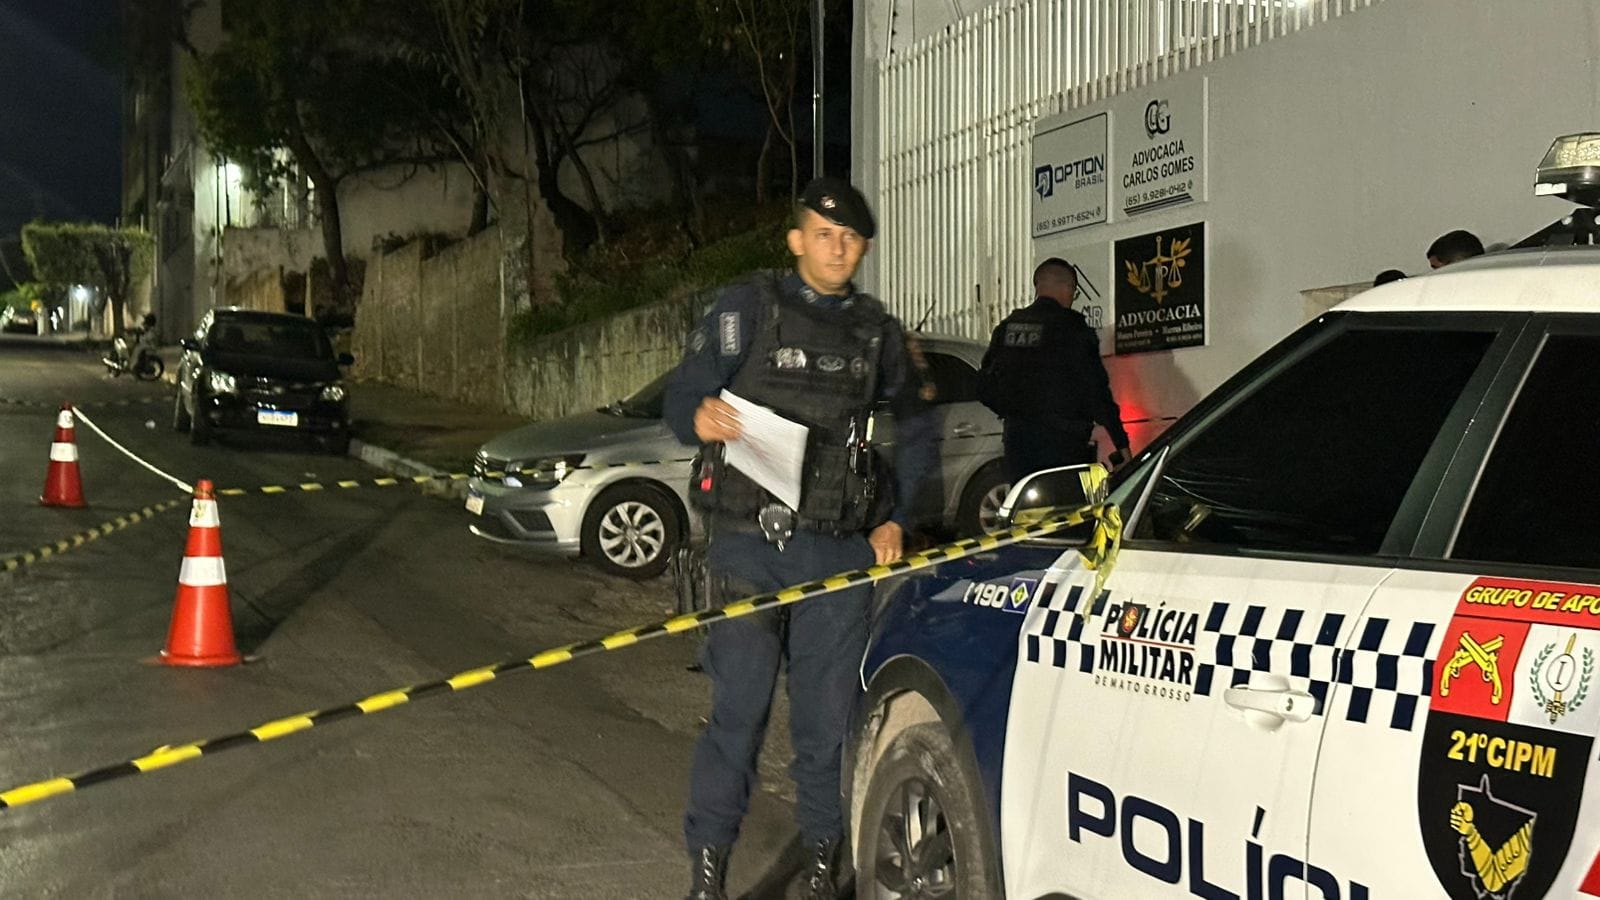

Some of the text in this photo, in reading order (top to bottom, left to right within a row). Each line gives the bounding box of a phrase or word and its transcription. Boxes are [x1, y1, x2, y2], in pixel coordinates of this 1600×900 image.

[1132, 139, 1185, 168] ADVOCACIA
[1054, 153, 1104, 183] OPTION
[1075, 174, 1104, 189] BRASIL
[1123, 156, 1195, 189] CARLOS GOMES
[1118, 303, 1201, 328] ADVOCACIA
[973, 582, 1010, 608] 190
[1465, 586, 1533, 607] GRUPO
[1532, 591, 1565, 611] DE
[1099, 639, 1195, 685] MILITAR
[1095, 675, 1192, 703] DE MATO GROSSO
